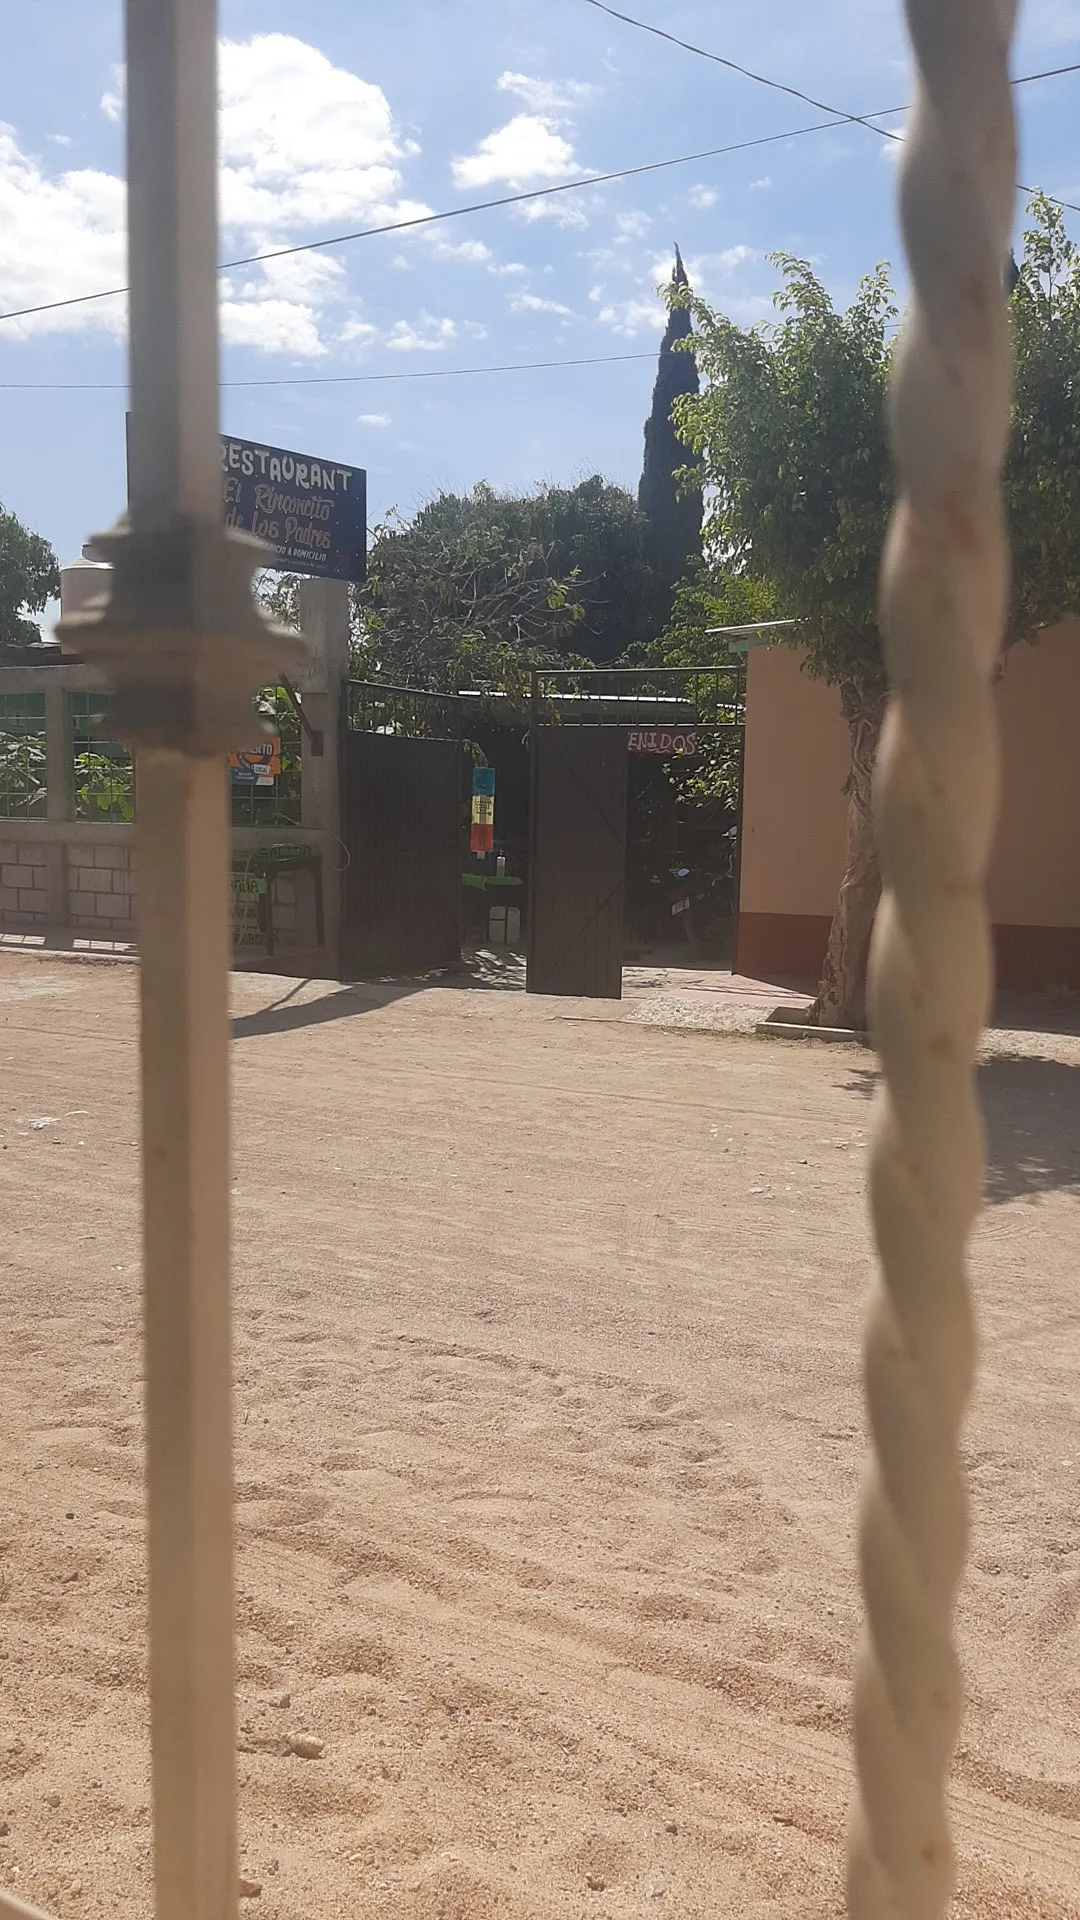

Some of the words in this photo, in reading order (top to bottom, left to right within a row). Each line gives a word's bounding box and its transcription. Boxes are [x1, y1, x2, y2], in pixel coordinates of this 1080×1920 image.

[221, 442, 353, 491] RESTAURANT
[223, 477, 242, 503] El
[255, 484, 335, 521] Rinconcito
[226, 507, 244, 529] de
[285, 517, 331, 549] Padres
[287, 547, 293, 557] A
[293, 548, 327, 562] DOMICILIO
[257, 845, 312, 861] SALIDA
